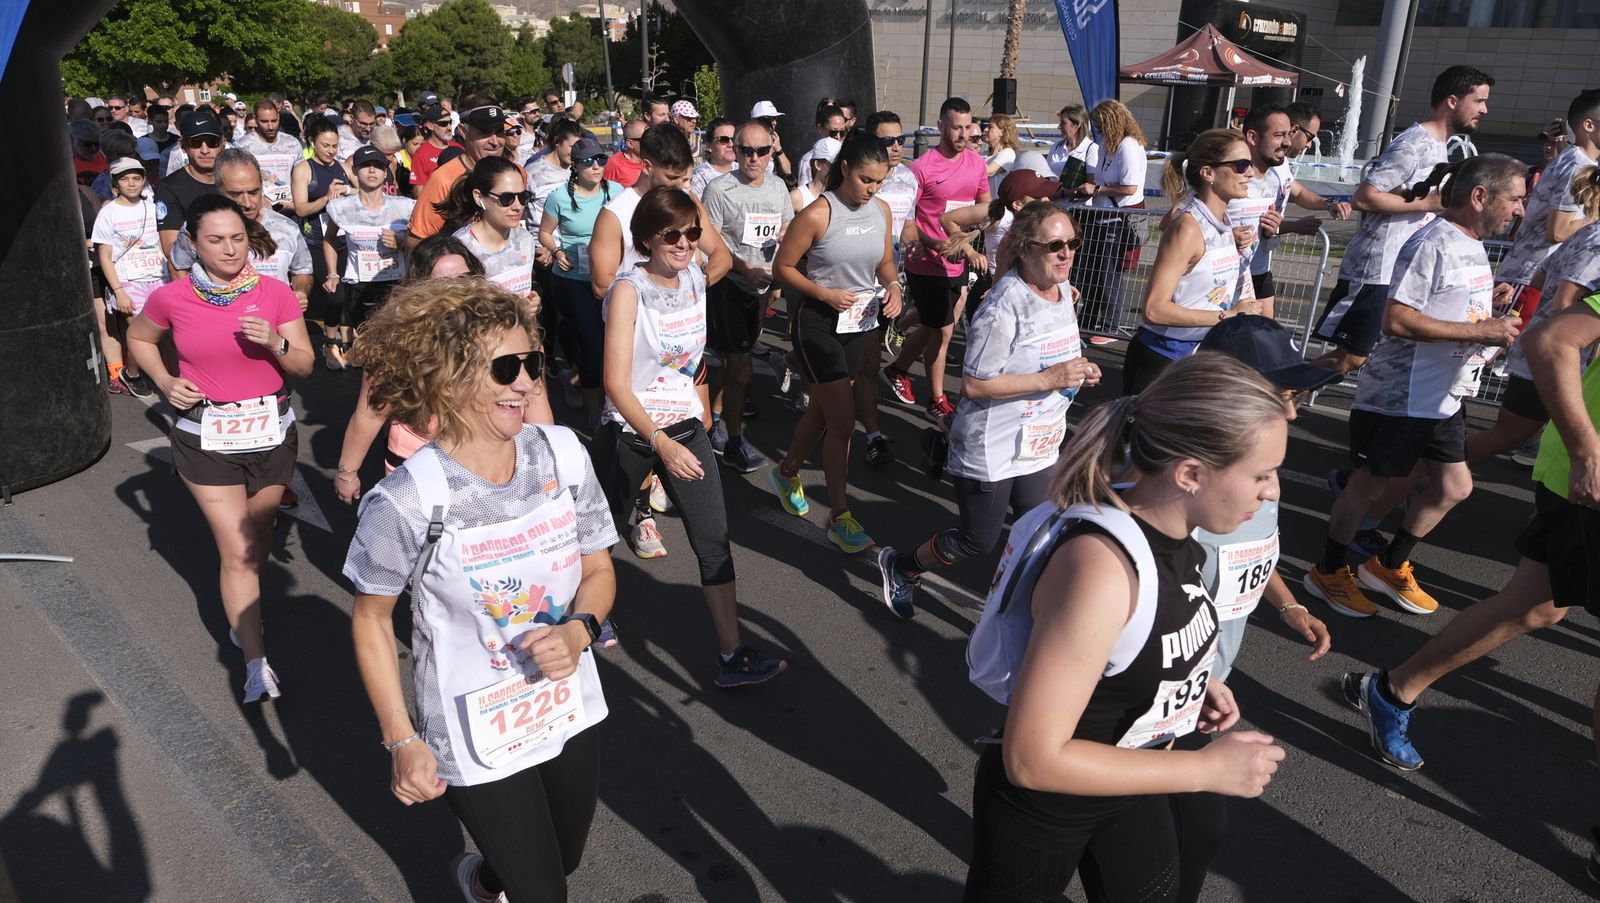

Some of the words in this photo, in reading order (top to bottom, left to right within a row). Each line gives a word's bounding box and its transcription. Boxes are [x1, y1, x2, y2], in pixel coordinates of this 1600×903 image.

[275, 192, 286, 200] 76
[755, 225, 776, 237] 101
[846, 226, 860, 236] NIKE
[211, 415, 270, 434] 1277
[1029, 429, 1064, 451] 1242
[470, 533, 527, 556] CARRERA
[527, 521, 550, 541] SIN
[1238, 559, 1272, 595] 189
[1161, 601, 1216, 669] PUMA
[489, 680, 571, 735] 1226
